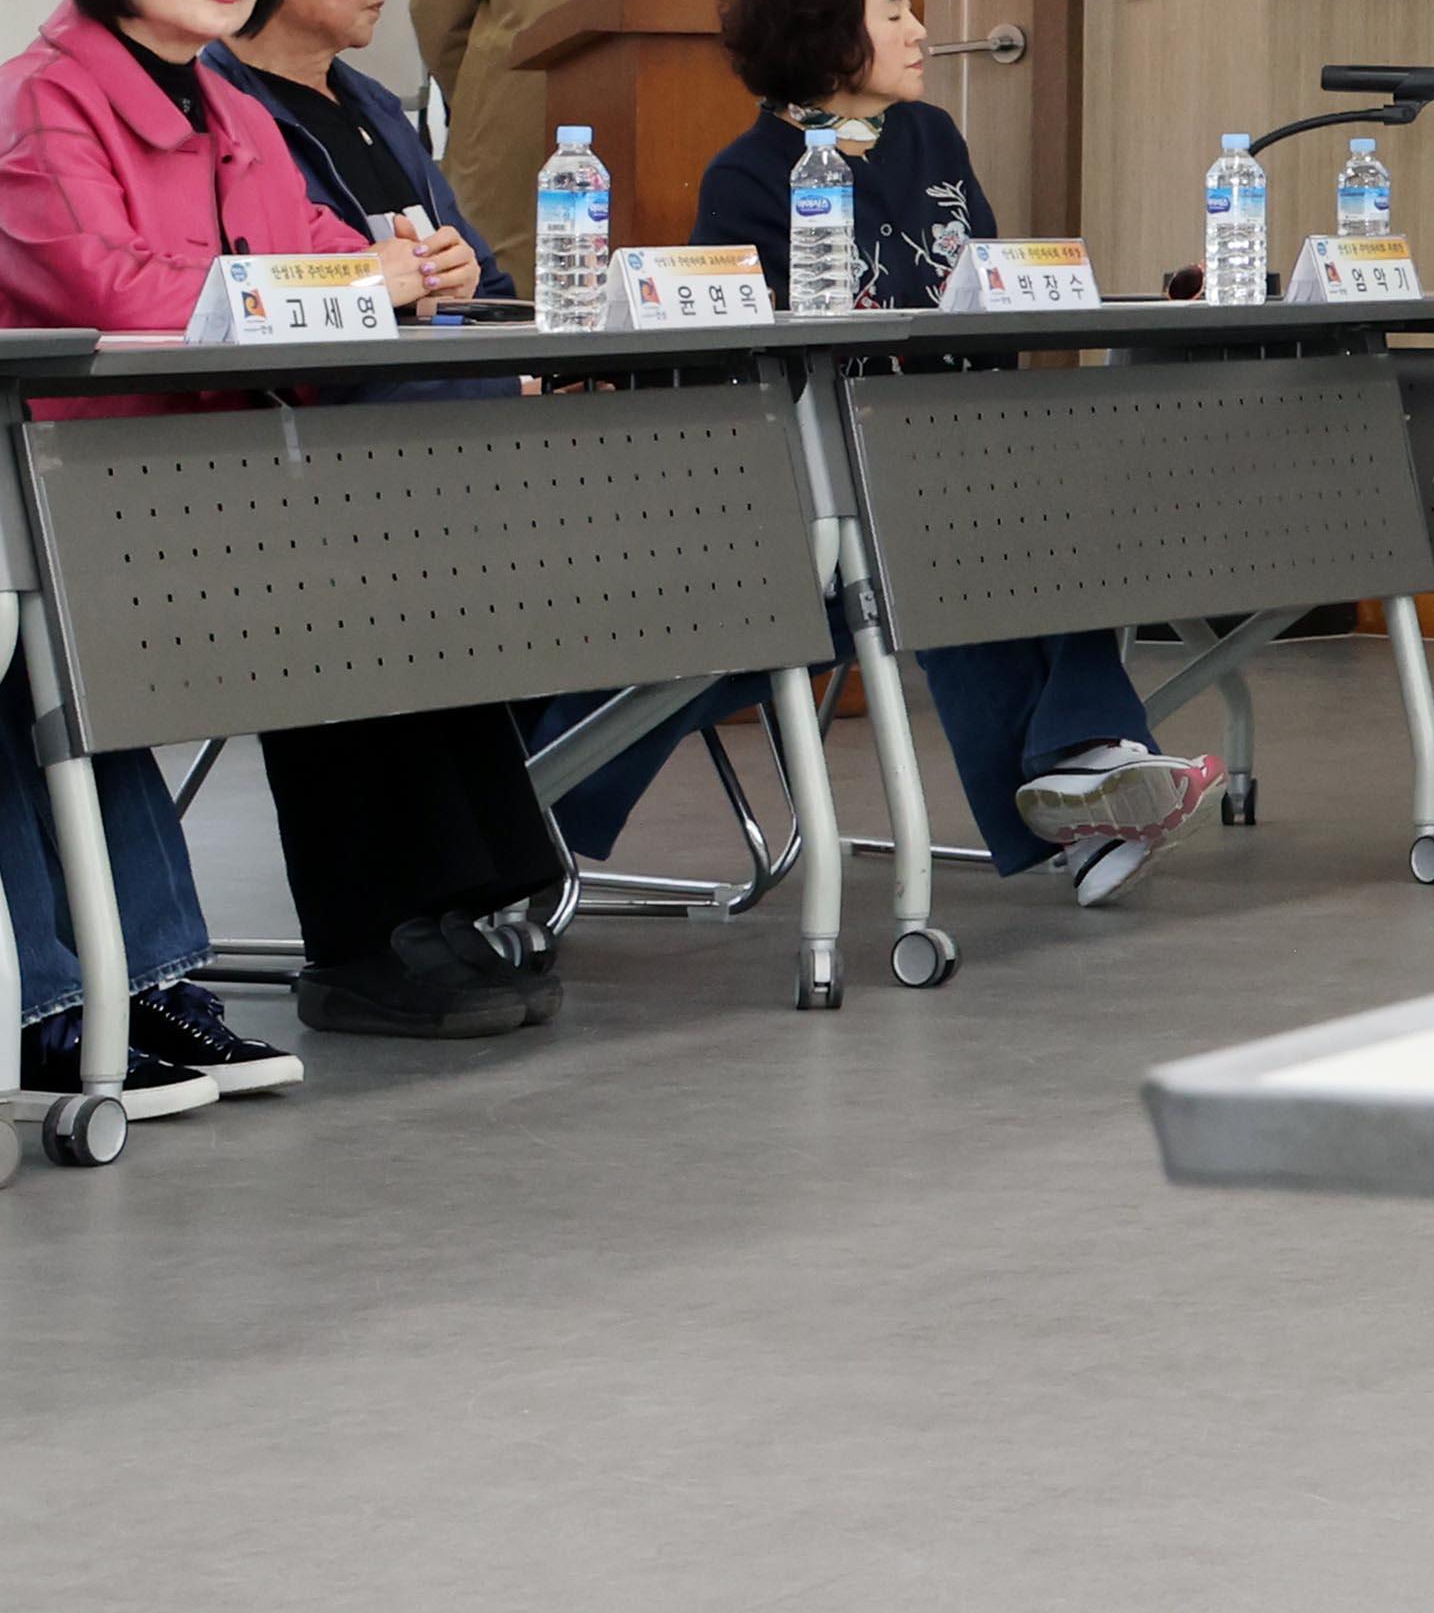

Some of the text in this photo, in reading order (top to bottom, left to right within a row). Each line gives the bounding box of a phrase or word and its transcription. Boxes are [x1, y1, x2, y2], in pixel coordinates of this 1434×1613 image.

[677, 284, 758, 317] 윤연옥
[1017, 273, 1085, 302] 박장수
[286, 295, 378, 330] 고세영
